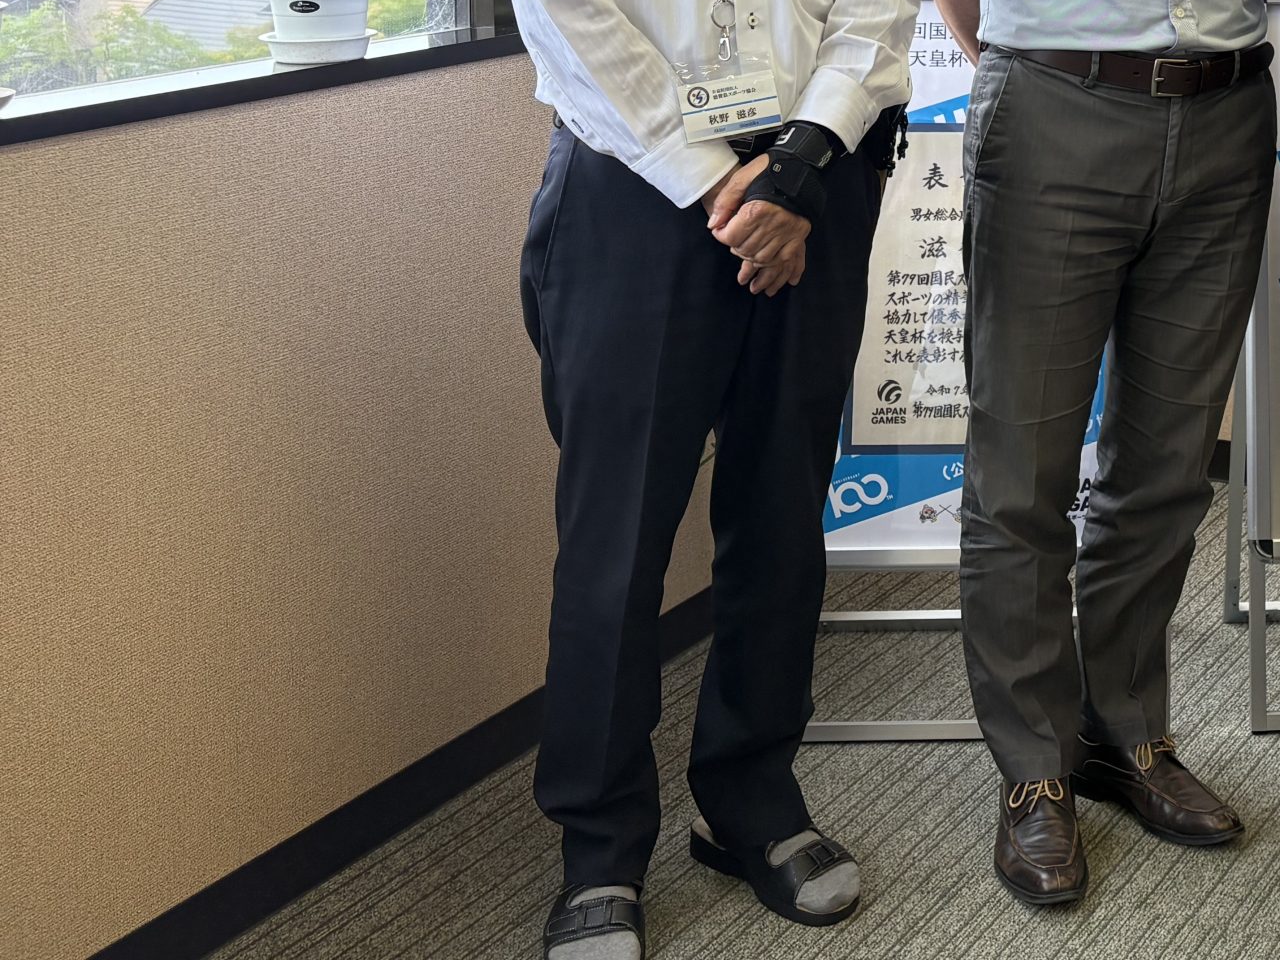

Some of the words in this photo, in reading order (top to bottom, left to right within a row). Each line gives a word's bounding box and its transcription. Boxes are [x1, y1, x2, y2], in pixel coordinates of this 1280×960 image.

[909, 50, 968, 68] 天皇杯
[883, 308, 967, 325] 協力して優秀
[872, 407, 906, 416] JAPAN
[871, 416, 906, 424] GAMES
